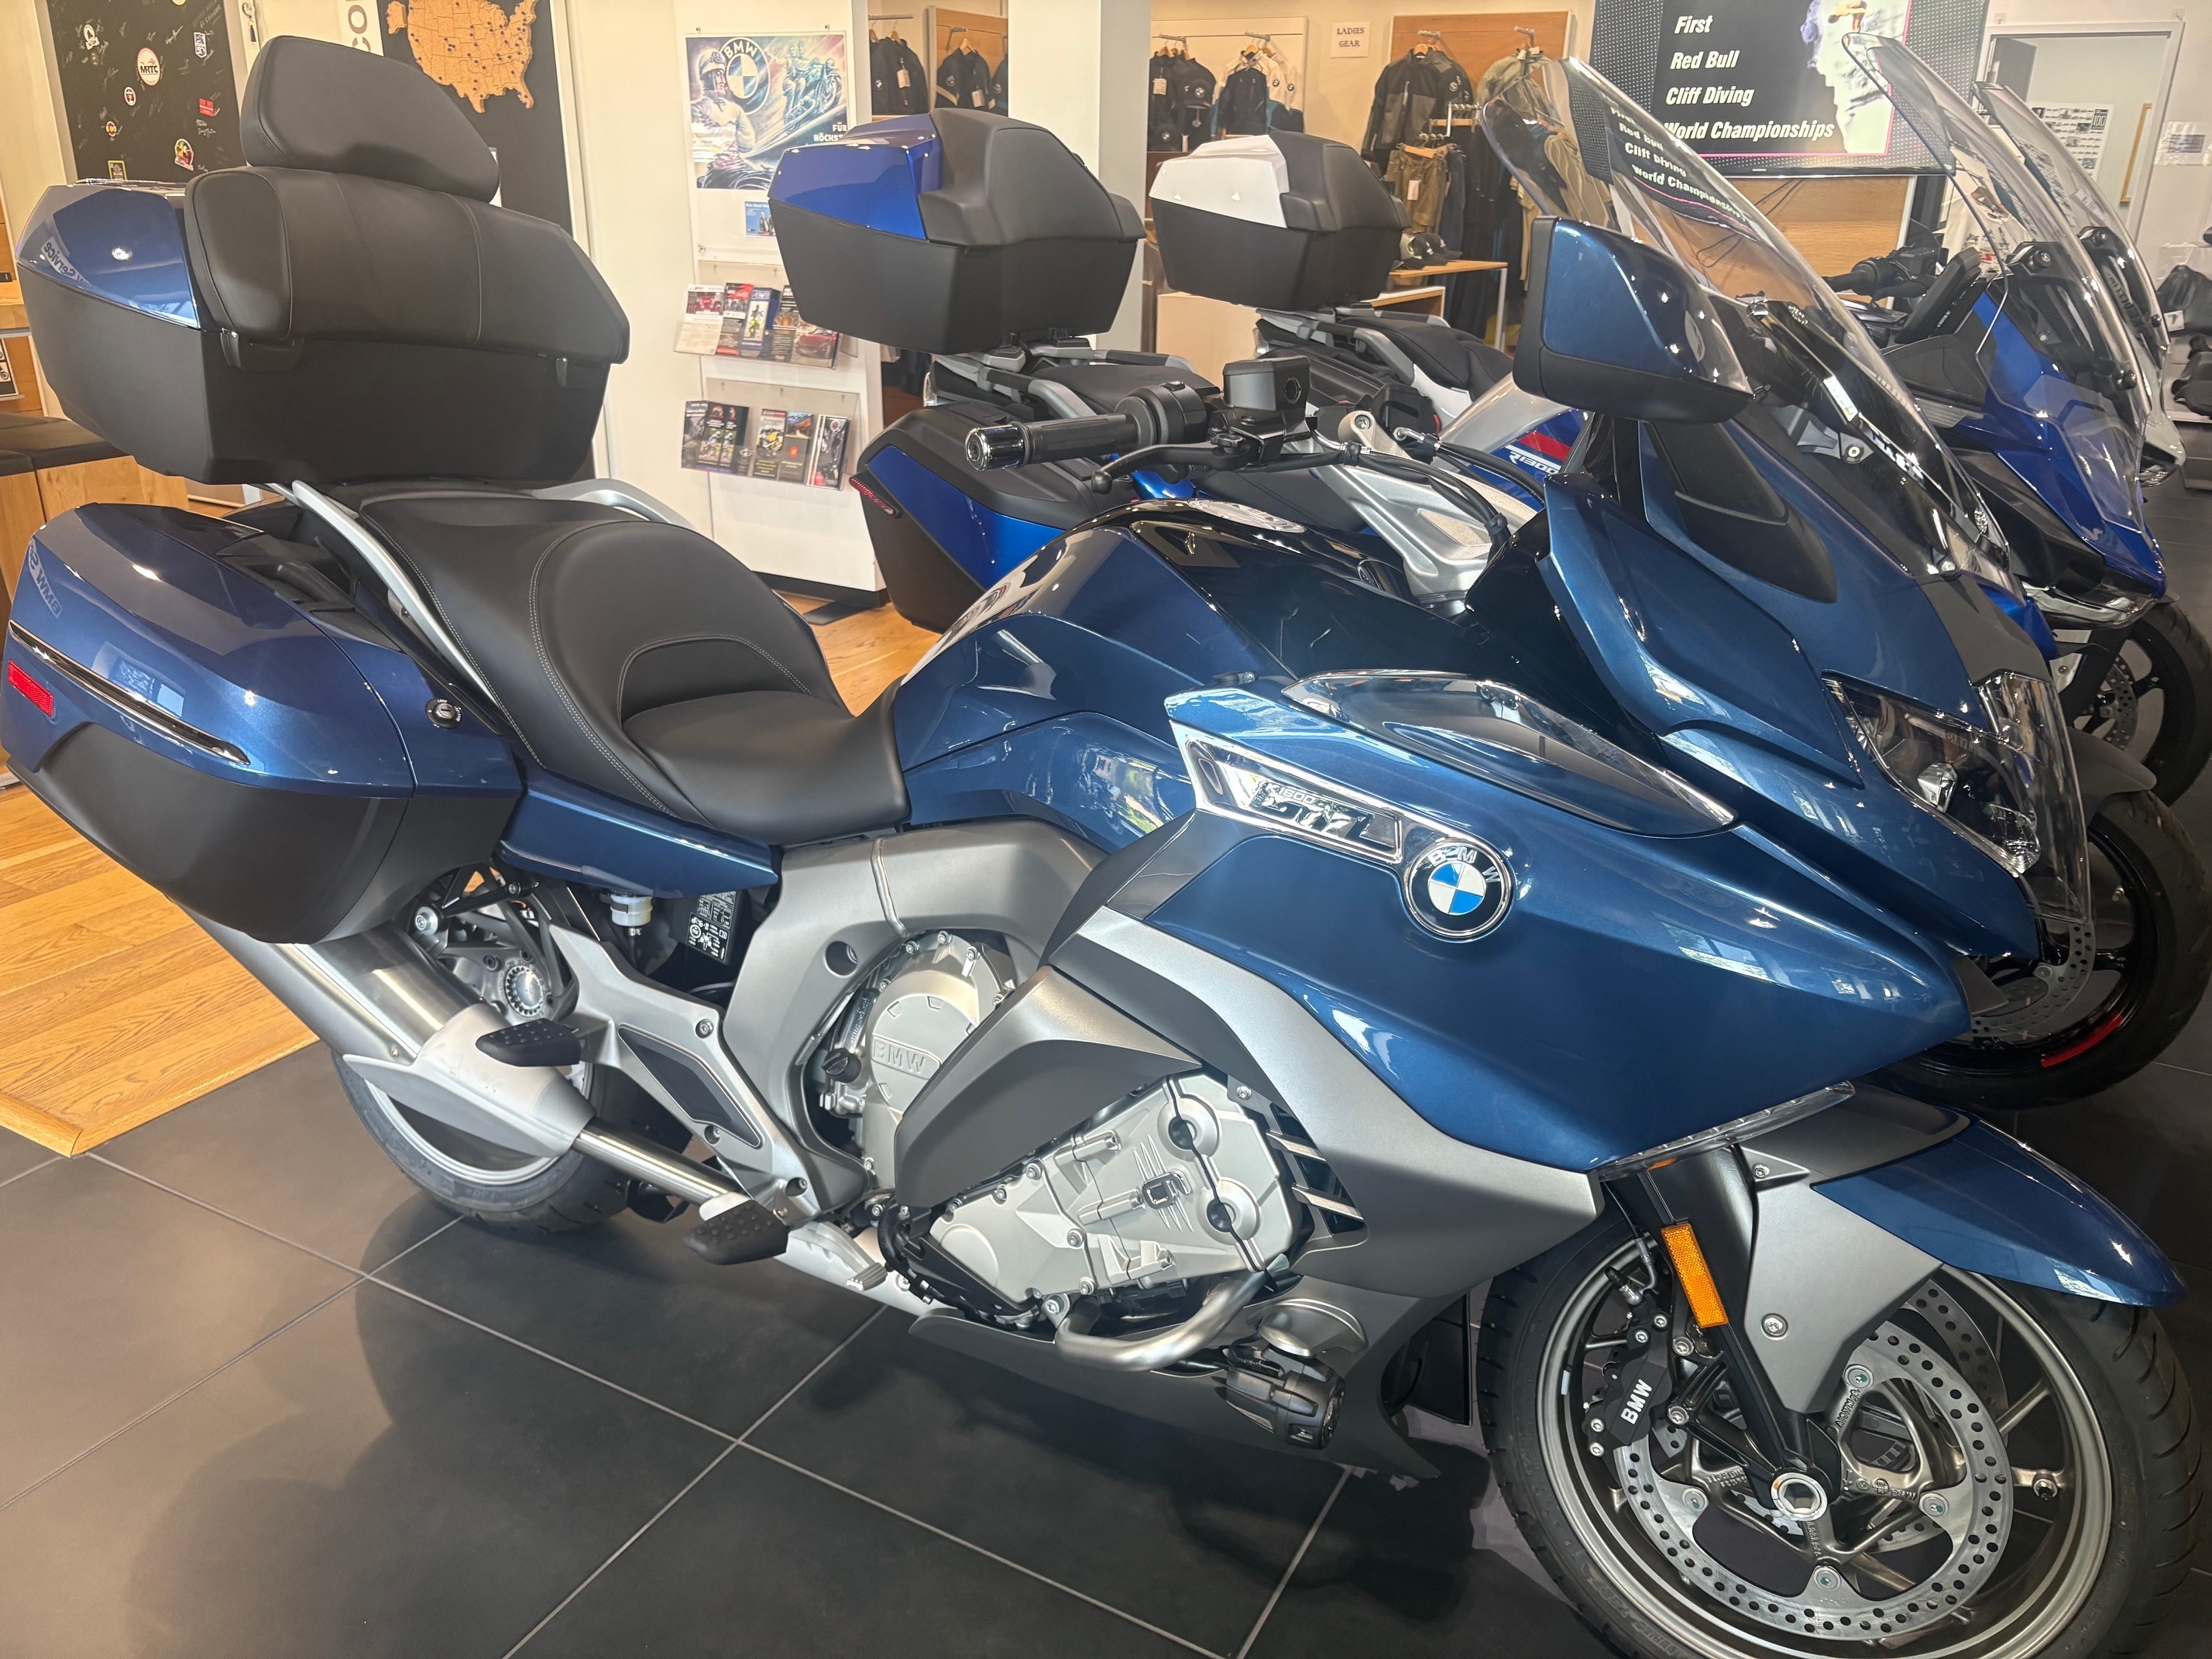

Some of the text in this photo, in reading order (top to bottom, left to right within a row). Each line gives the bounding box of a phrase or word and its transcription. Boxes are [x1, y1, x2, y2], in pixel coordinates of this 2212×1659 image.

[1674, 15, 1713, 34] First
[723, 40, 757, 59] BMW
[1670, 50, 1740, 70] Red Bull
[139, 65, 159, 74] MRTC
[1665, 85, 1755, 107] Cliff Diving
[832, 122, 848, 132] FÜR
[1664, 119, 1836, 142] World Championships
[1427, 846, 1502, 883] BMW
[874, 1041, 926, 1075] BMW
[1620, 1378, 1653, 1424] BMW
